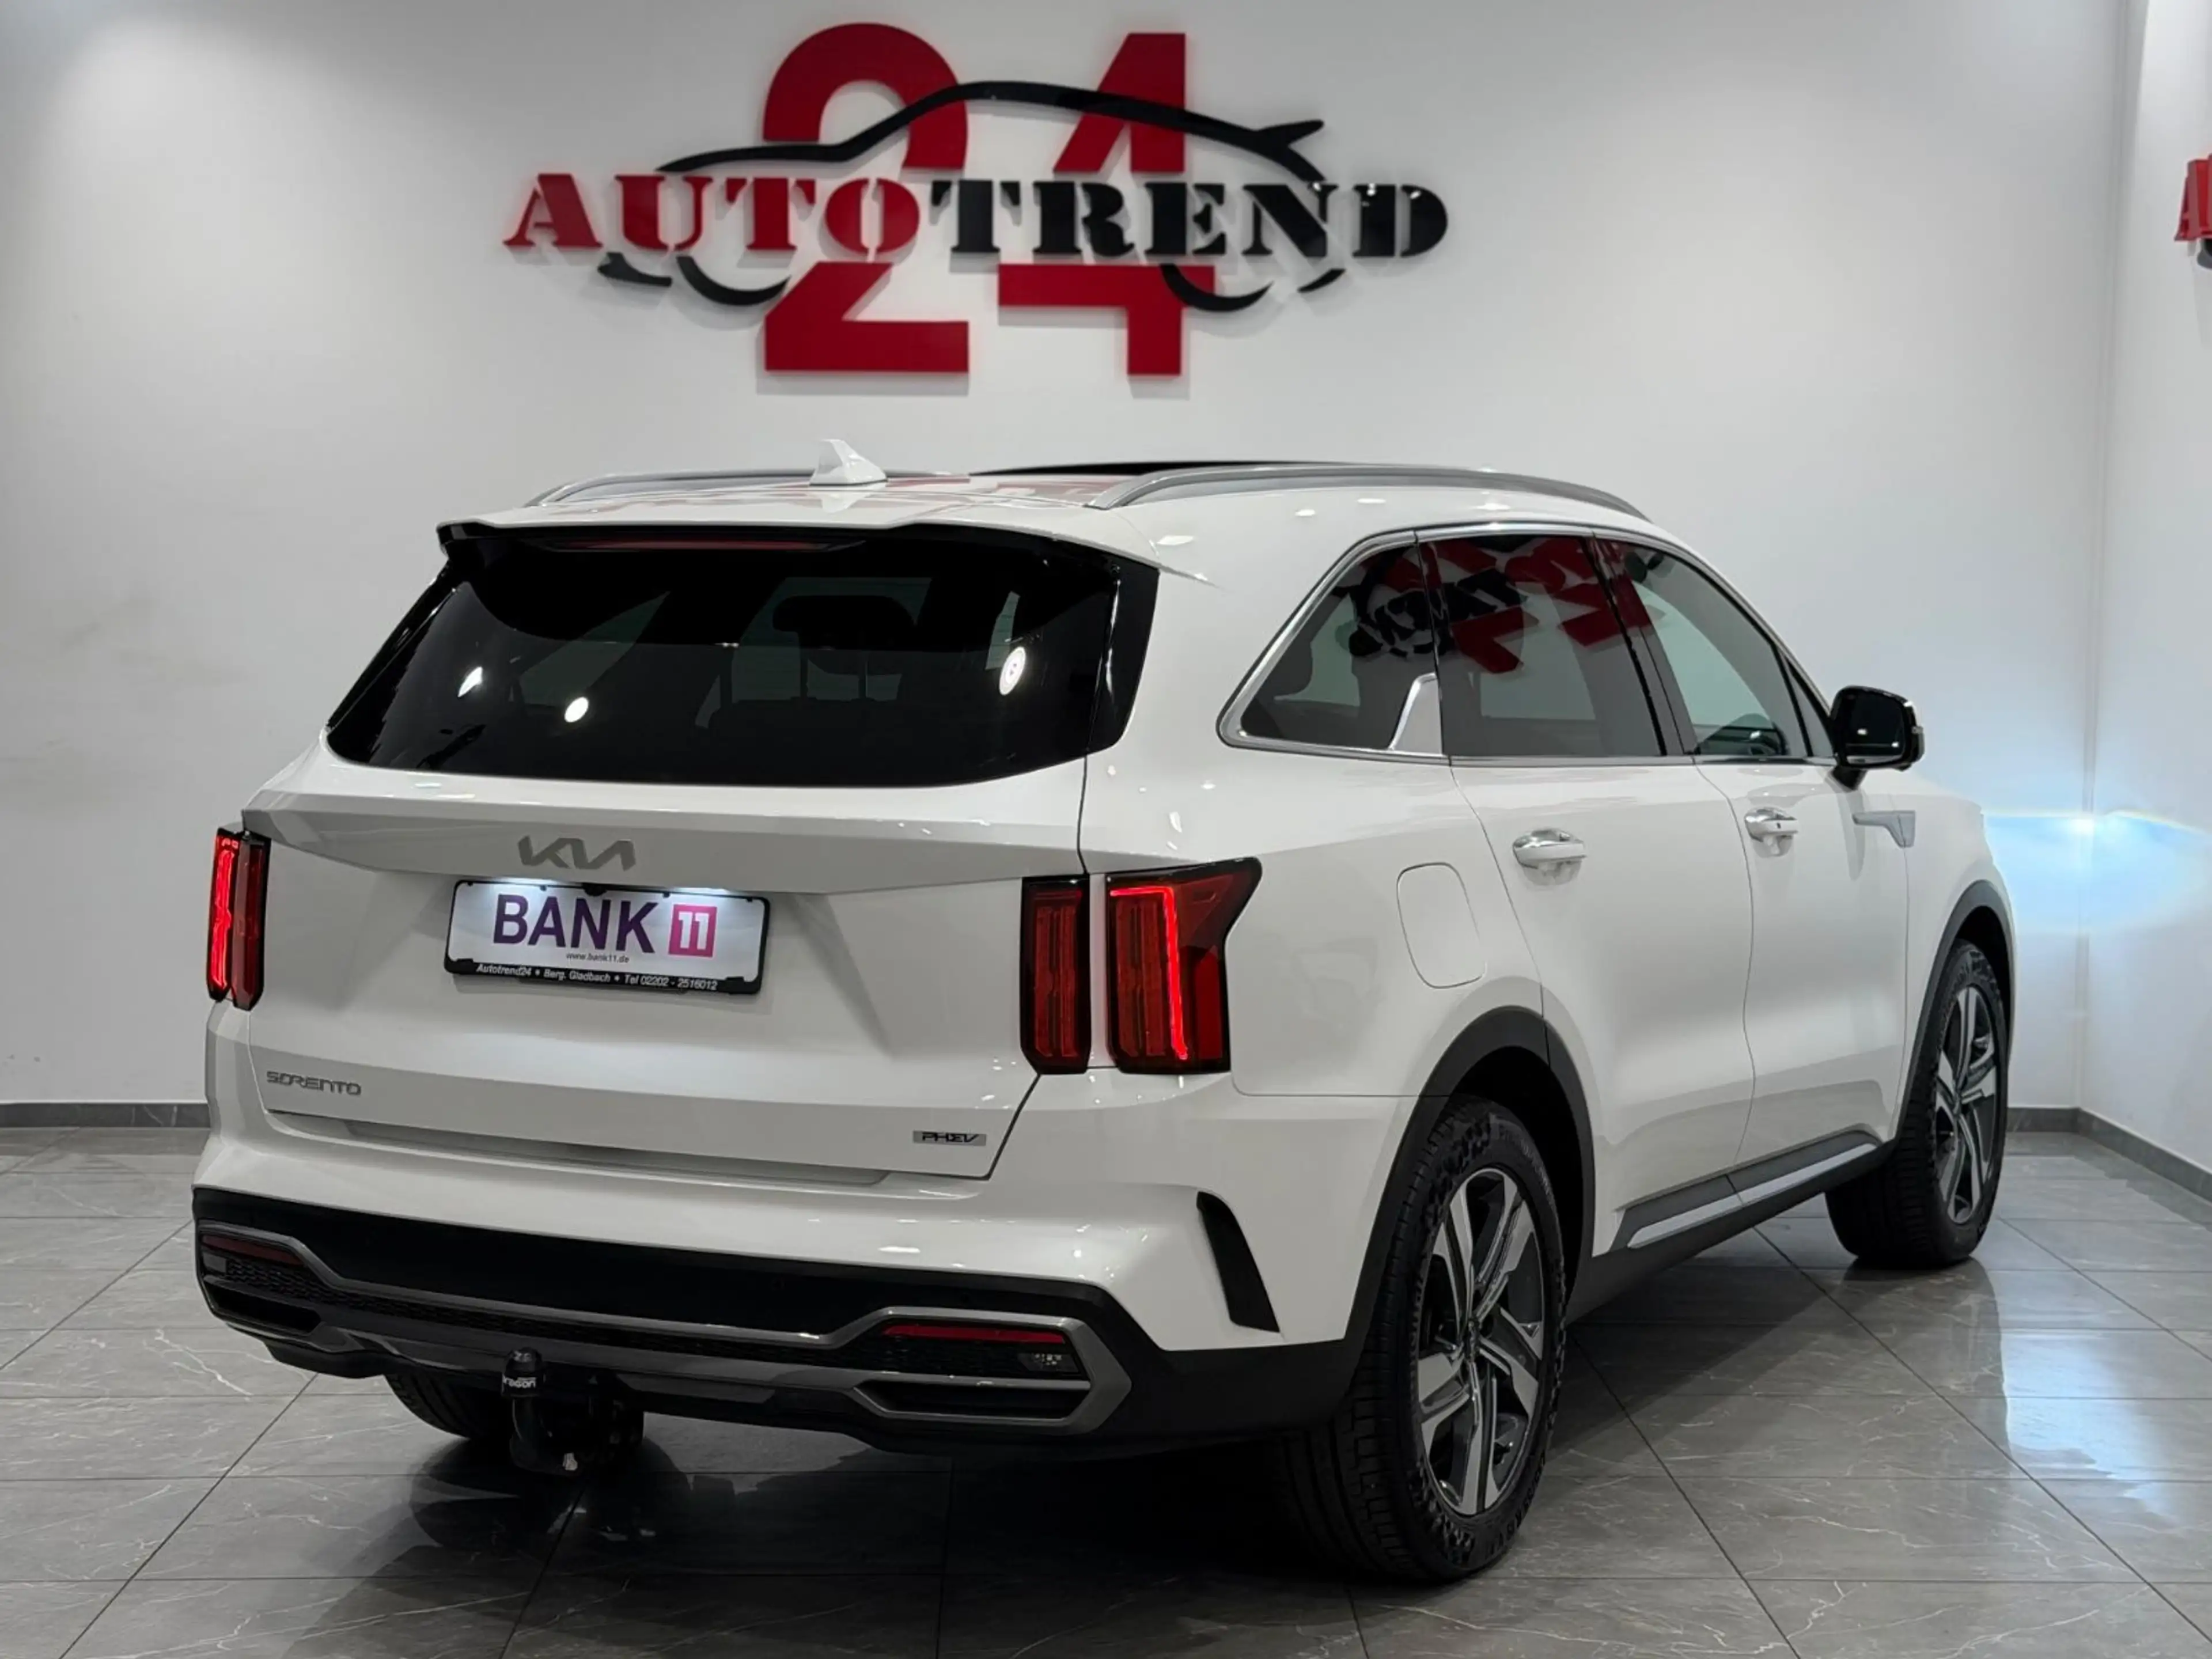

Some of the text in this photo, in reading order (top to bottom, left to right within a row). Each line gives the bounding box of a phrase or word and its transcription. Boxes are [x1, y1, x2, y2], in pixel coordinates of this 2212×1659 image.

[762, 22, 1213, 375] 24
[503, 172, 1448, 259] AUTOTREND
[517, 836, 635, 871] KIA
[493, 893, 709, 953] BANK 11
[566, 952, 630, 963] www.bank11.de
[476, 963, 532, 976] Autotrend24
[544, 968, 566, 981] Berg.
[569, 969, 611, 982] Gladbach
[625, 974, 638, 984] Tel
[641, 975, 669, 987] 02202
[267, 1071, 361, 1096] SORENTO
[922, 1131, 979, 1143] PHEV
